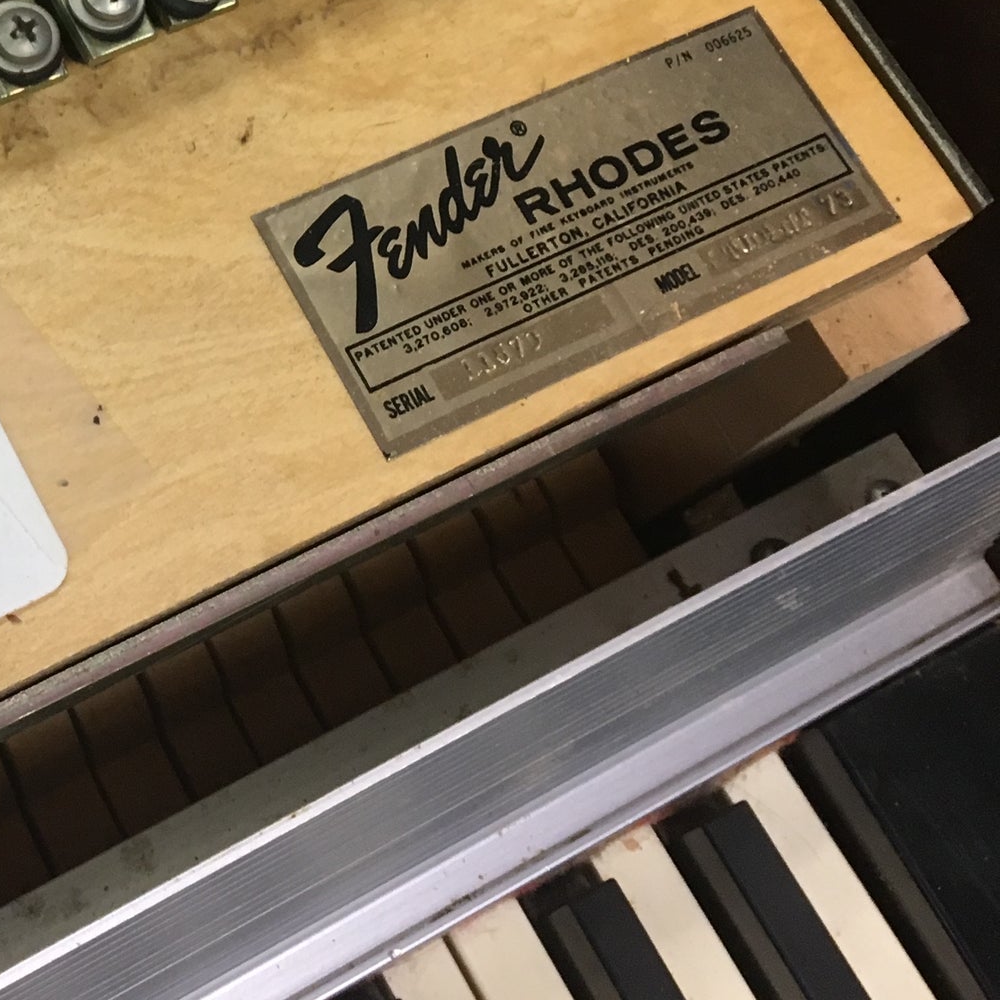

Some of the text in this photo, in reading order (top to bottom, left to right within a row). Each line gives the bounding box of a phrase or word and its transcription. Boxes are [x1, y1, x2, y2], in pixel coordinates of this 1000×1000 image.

[664, 25, 753, 69] P/N 006625
[512, 109, 731, 226] RHODES
[752, 167, 802, 196] 200,440
[293, 133, 546, 335] Fender
[461, 161, 695, 270] MAKERS OF FINE KEYBOARD INSTRUMENTS
[484, 181, 688, 278] FULLERTON, CALIFORNIA
[353, 325, 422, 362] PATENTED
[423, 305, 468, 330] UNDER
[469, 291, 497, 310] ONE
[498, 283, 518, 298] OR
[519, 266, 557, 287] MORE
[558, 257, 575, 270] OF
[577, 243, 605, 263] THE
[605, 210, 677, 248] FOLLOWING
[678, 193, 722, 217] UNITED
[722, 168, 771, 197] STATES
[522, 287, 570, 314] OTHER
[578, 256, 640, 289] PATENTS
[648, 225, 706, 257] PENDING
[653, 262, 702, 294] MODEL
[382, 384, 436, 420] SERIAL
